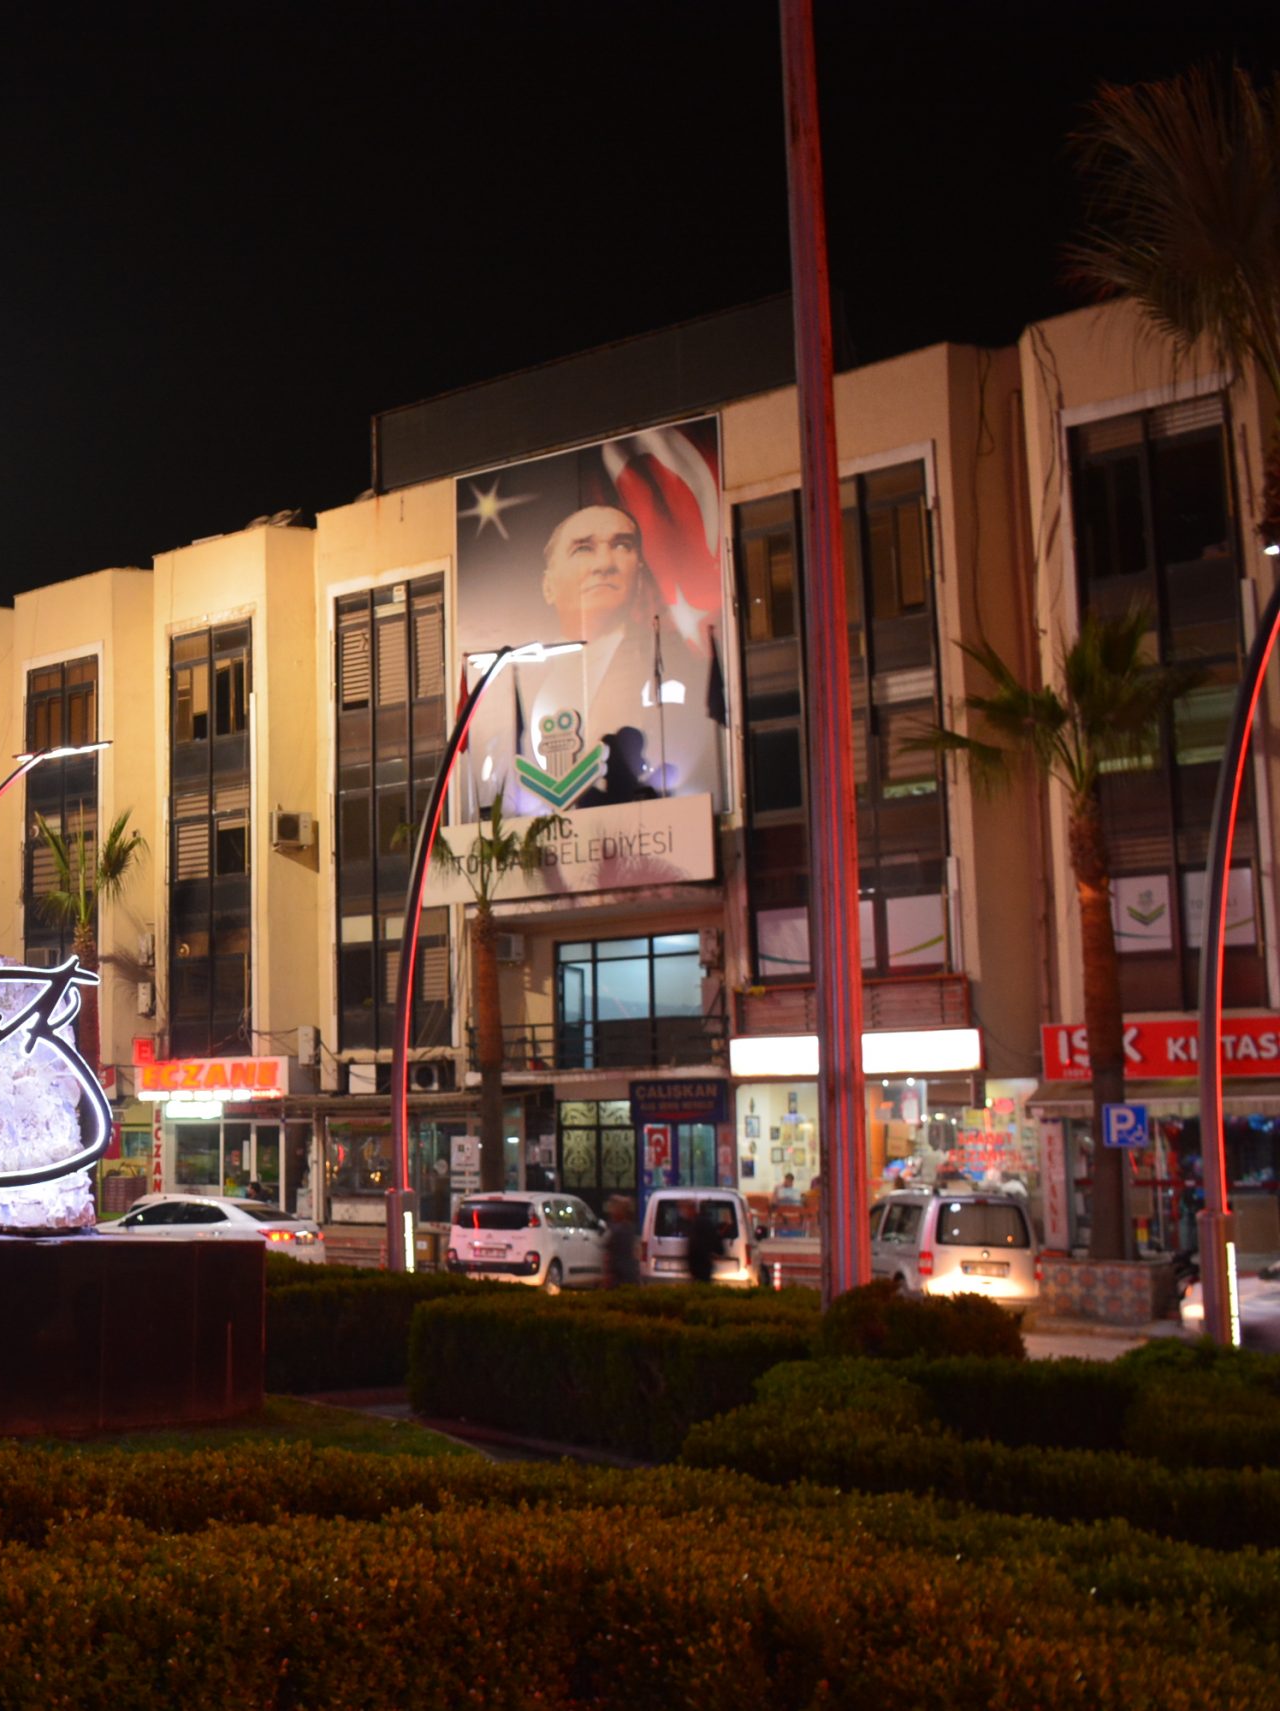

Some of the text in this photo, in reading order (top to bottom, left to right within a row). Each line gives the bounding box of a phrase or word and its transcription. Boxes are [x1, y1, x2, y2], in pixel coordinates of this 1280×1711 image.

[543, 826, 673, 867] BELEDİYESİ
[142, 1062, 279, 1088] ECZANE
[1110, 1107, 1136, 1143] P
